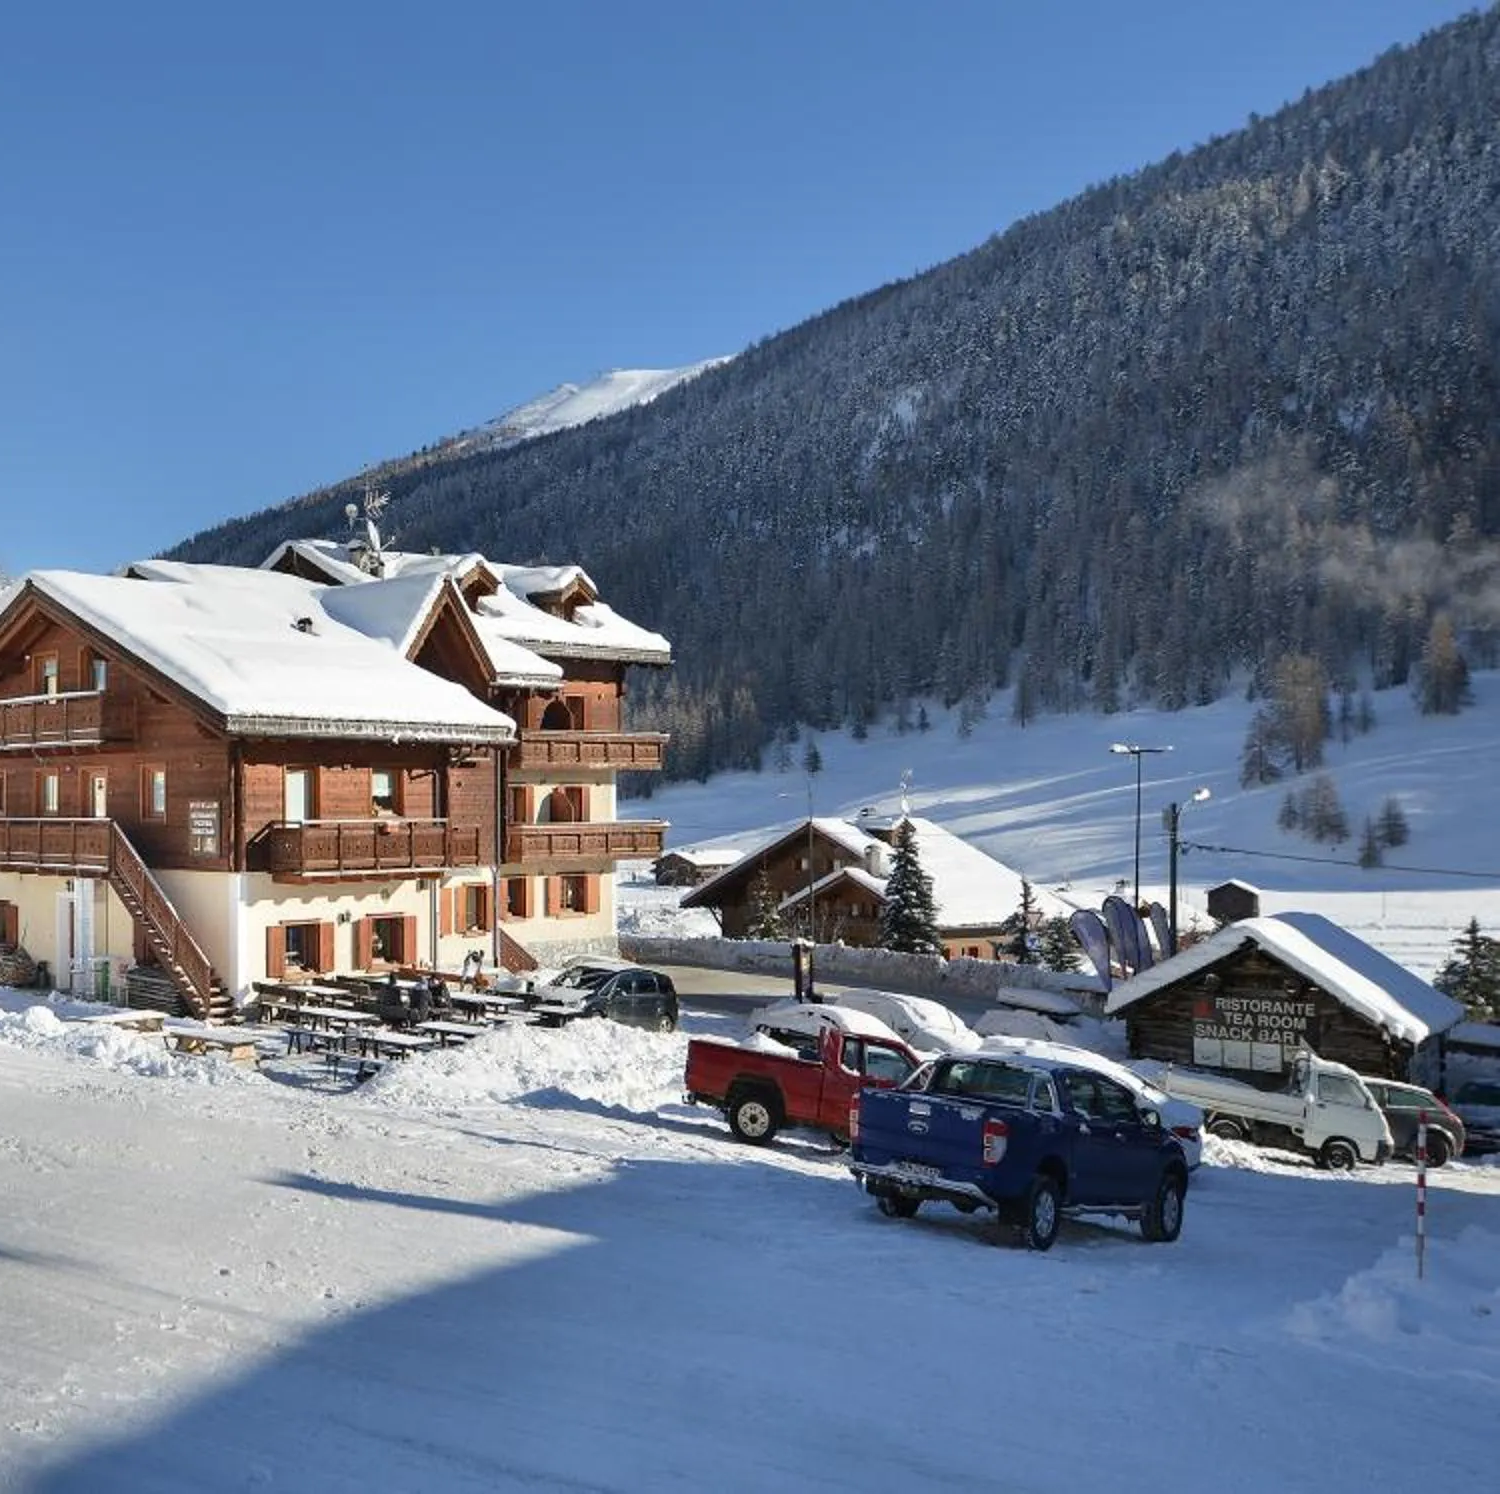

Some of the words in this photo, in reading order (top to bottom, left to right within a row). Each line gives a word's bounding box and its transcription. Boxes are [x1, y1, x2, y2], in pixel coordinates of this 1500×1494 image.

[1215, 997, 1315, 1016] RISTORANTE
[1223, 1011, 1255, 1027] TEA
[1257, 1015, 1307, 1031] ROOM
[1195, 1023, 1253, 1041] SNACK
[1258, 1029, 1295, 1044] BAR
